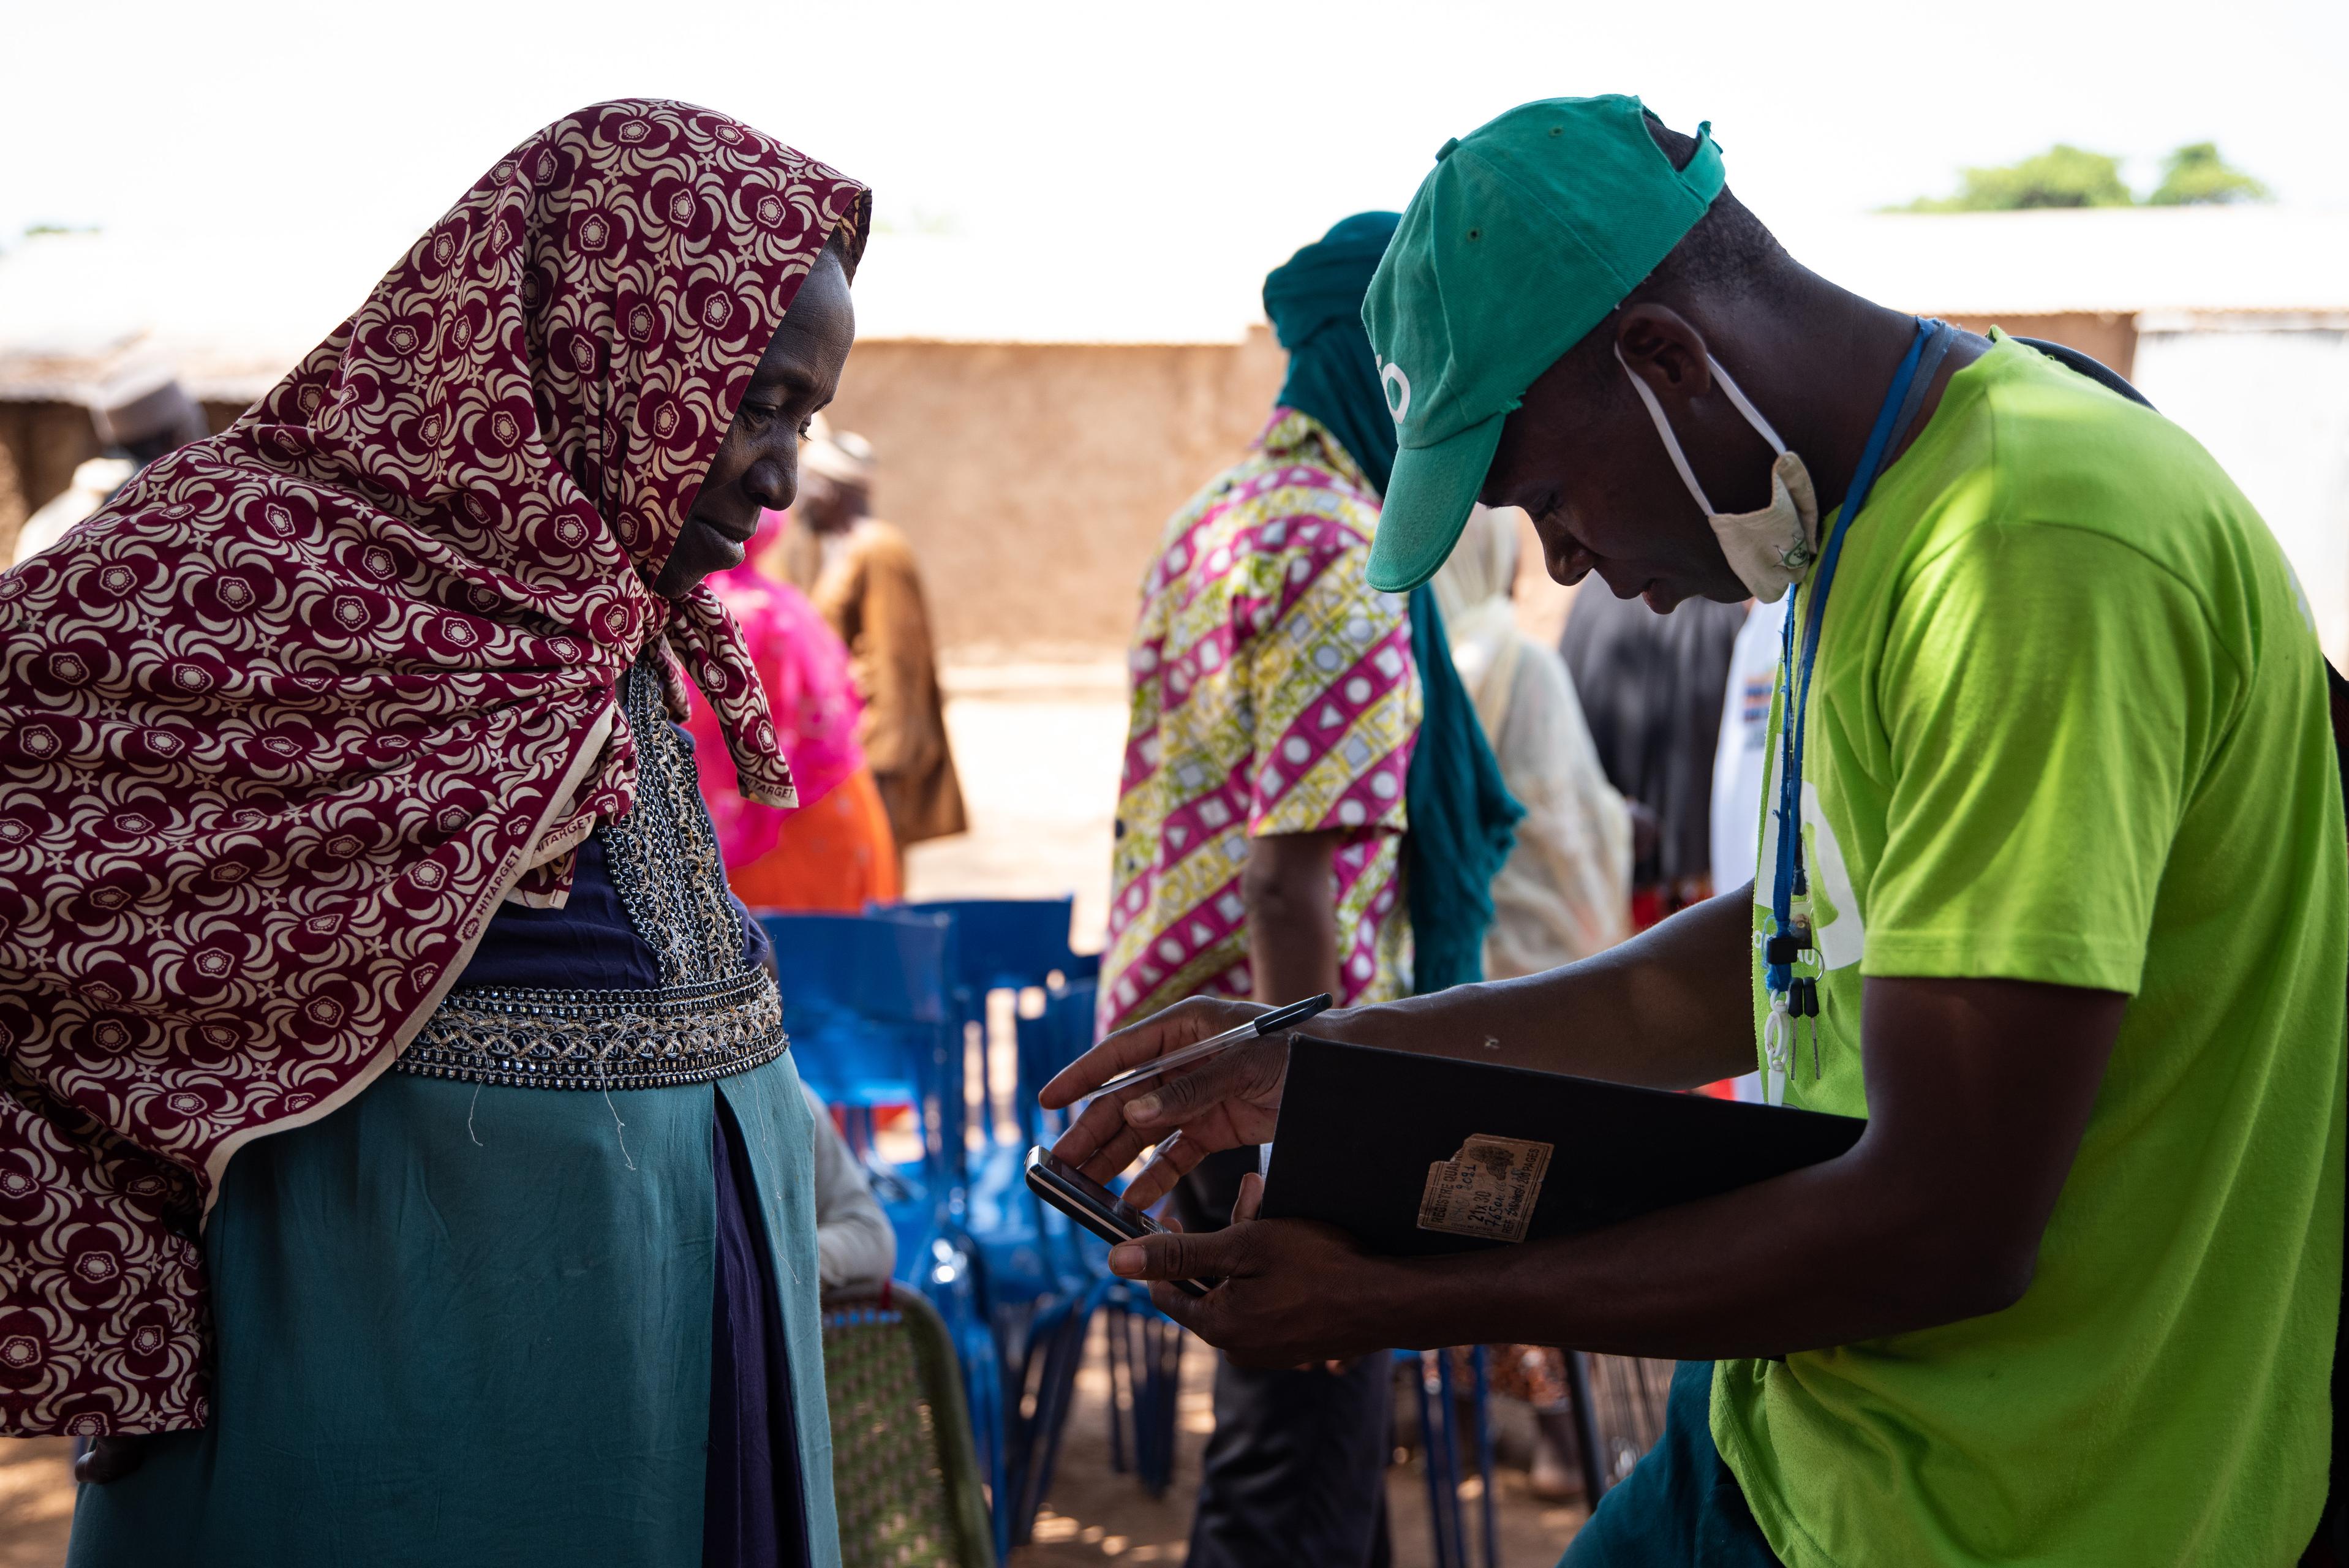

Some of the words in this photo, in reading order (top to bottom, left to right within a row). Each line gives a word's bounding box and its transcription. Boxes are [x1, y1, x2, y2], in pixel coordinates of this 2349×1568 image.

[476, 850, 520, 916] HITARGET
[1522, 1148, 1539, 1172] PAGES
[1431, 1183, 1454, 1223] REGISTRE
